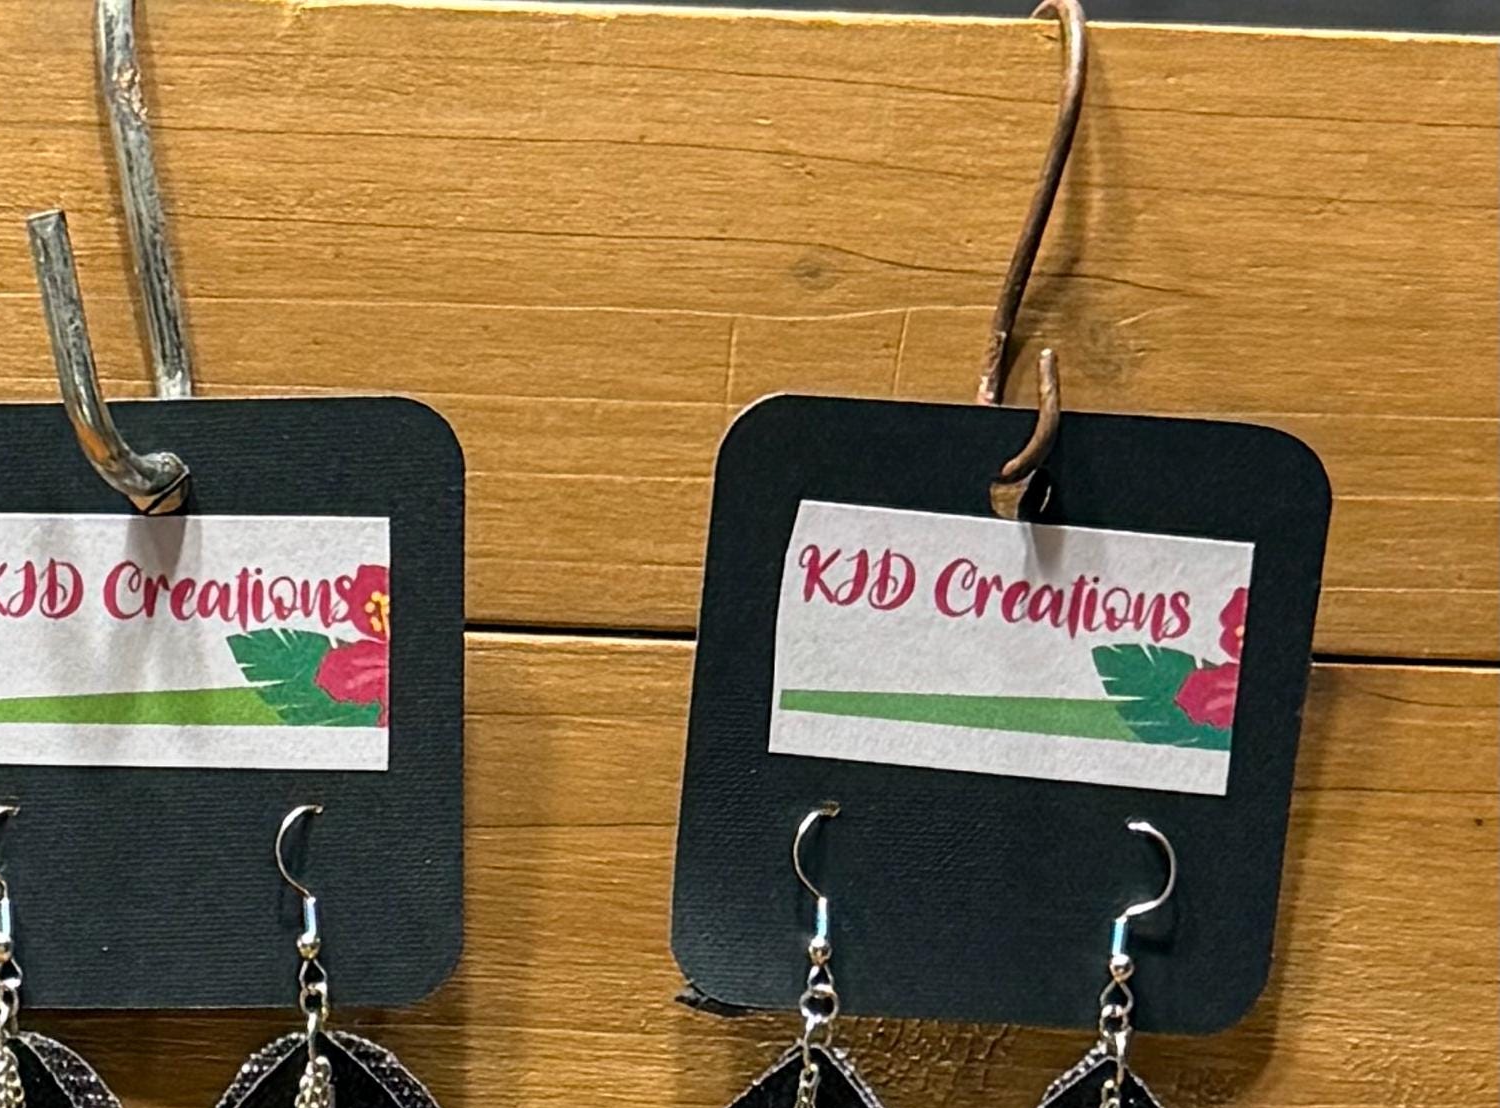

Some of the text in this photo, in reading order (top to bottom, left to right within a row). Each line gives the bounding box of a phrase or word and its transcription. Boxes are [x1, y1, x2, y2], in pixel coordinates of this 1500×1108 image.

[102, 560, 356, 632] Creations
[798, 544, 1191, 644] KJD Creations
